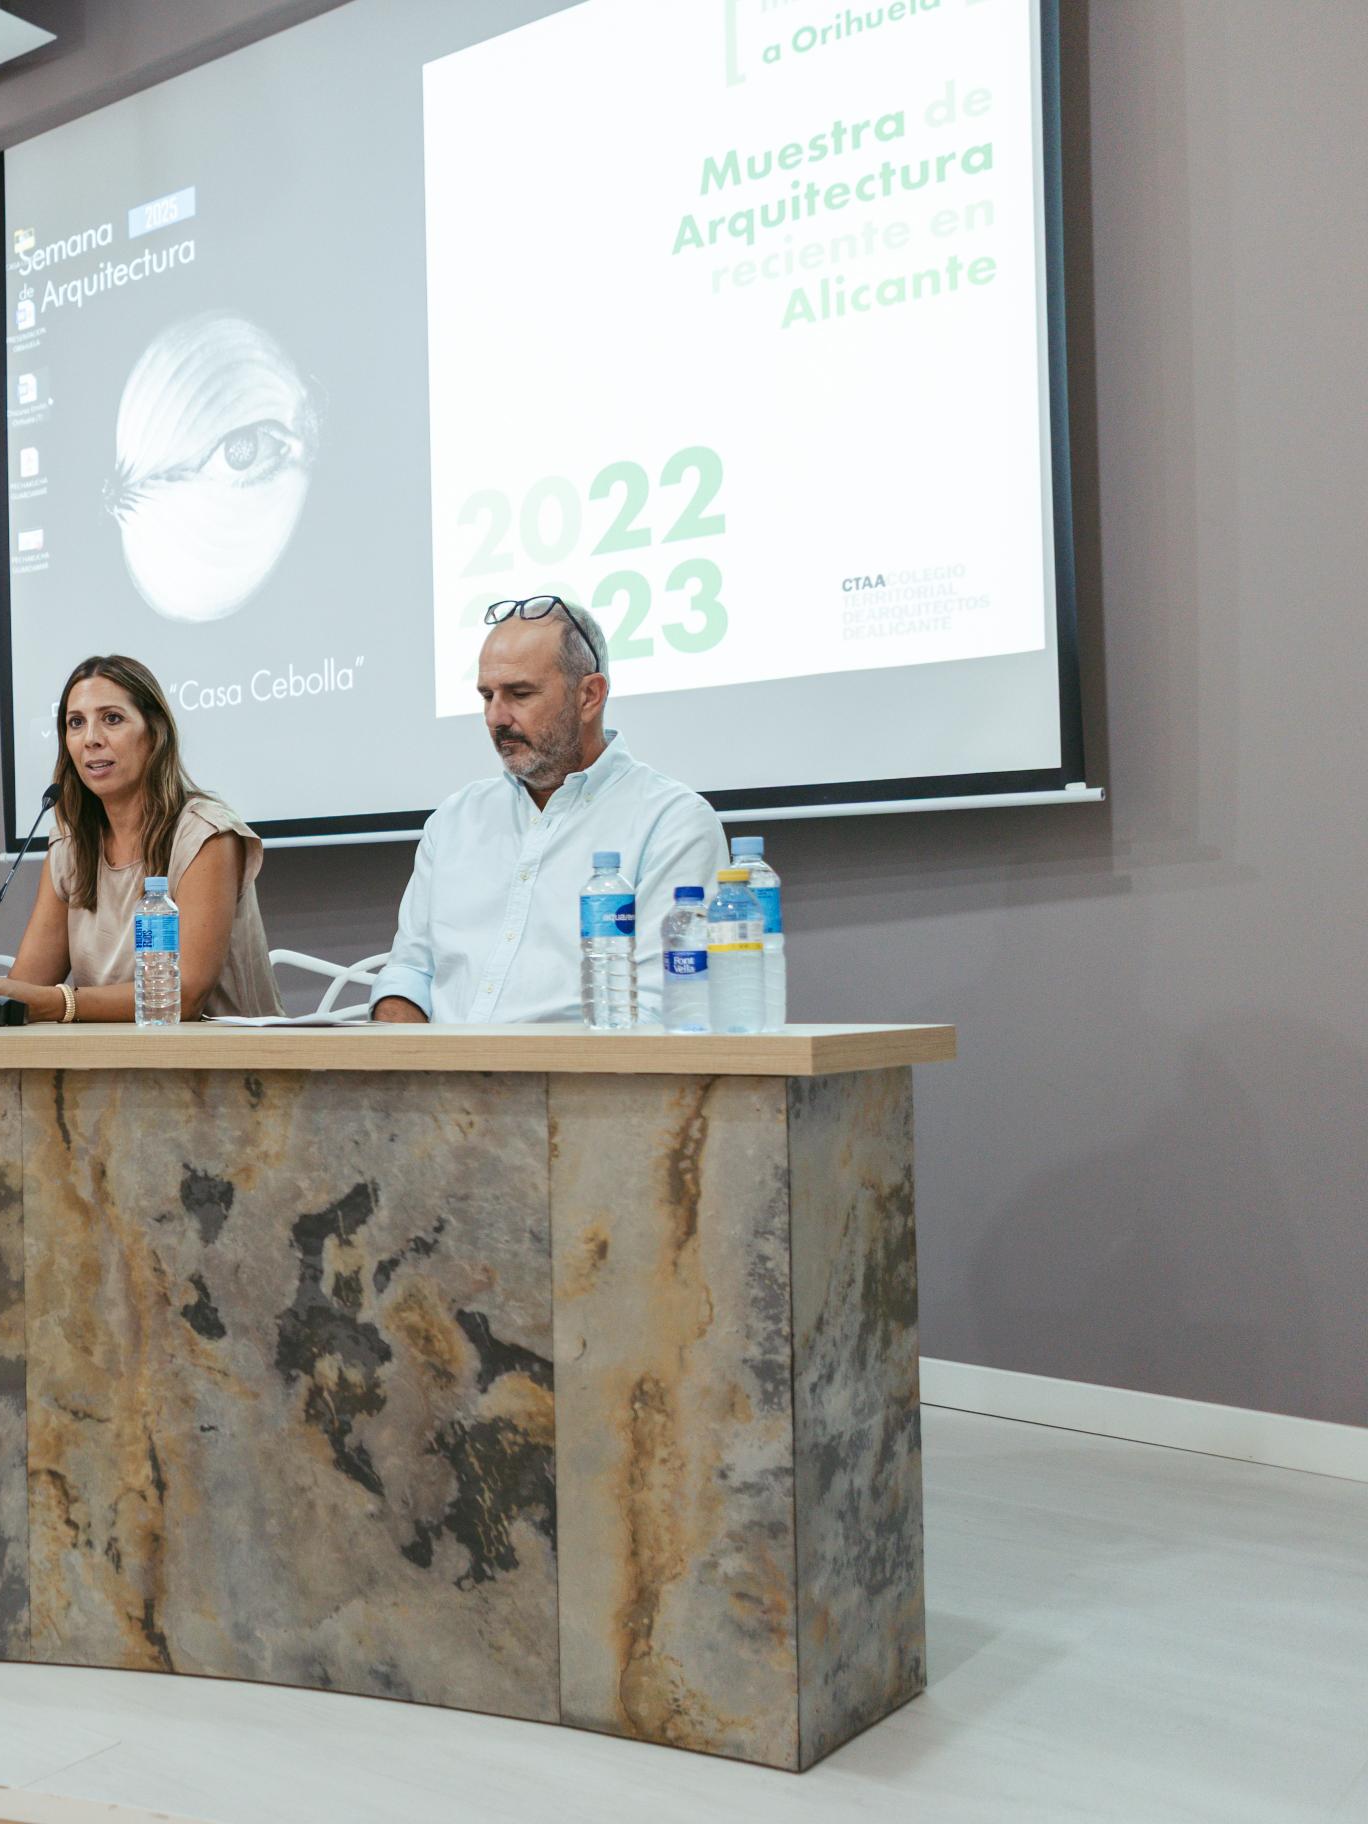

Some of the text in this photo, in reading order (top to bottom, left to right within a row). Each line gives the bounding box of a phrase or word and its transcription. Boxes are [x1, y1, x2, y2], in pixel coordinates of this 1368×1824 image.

[761, 0, 941, 64] a Orihuela
[699, 78, 993, 196] Muestra de
[671, 142, 994, 255] Arquitectura
[19, 222, 113, 276] Semana
[19, 238, 196, 313] de Arquitectura
[710, 199, 995, 294] reciente en
[779, 254, 998, 330] Alicante
[457, 445, 727, 579] 2022
[459, 557, 729, 682] 23
[841, 573, 887, 592] CTAA
[842, 582, 958, 608] TERRITORIAL
[673, 956, 696, 965] Font
